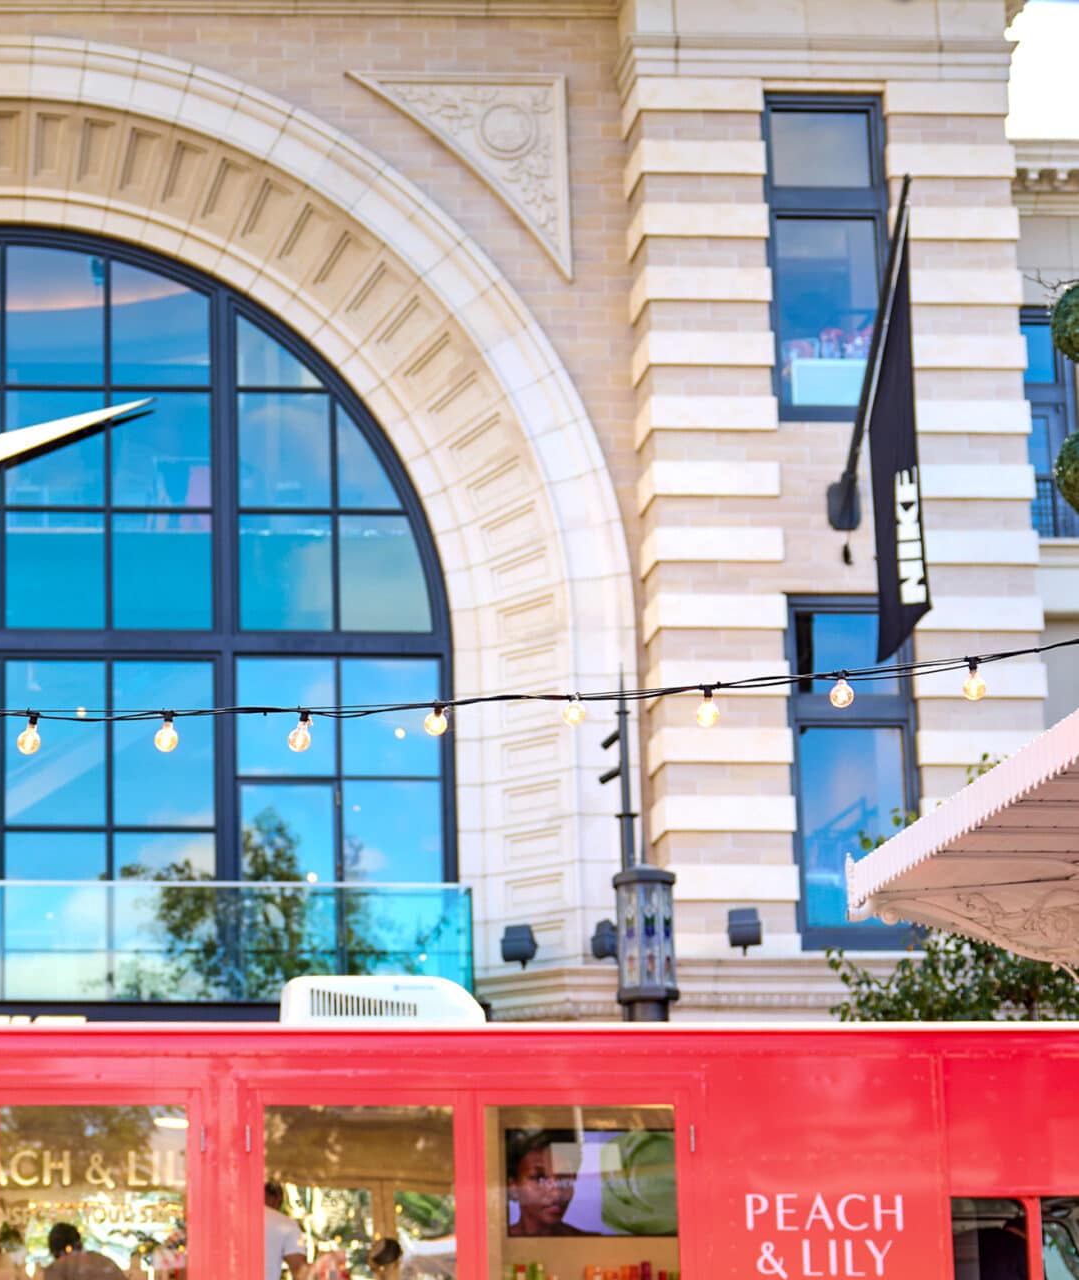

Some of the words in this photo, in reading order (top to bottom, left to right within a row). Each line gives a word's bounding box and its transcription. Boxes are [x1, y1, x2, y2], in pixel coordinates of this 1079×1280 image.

[894, 465, 927, 605] NIKE
[85, 1153, 115, 1189] &
[745, 1193, 904, 1232] PEACH
[756, 1241, 788, 1280] &
[802, 1239, 893, 1277] LILY
